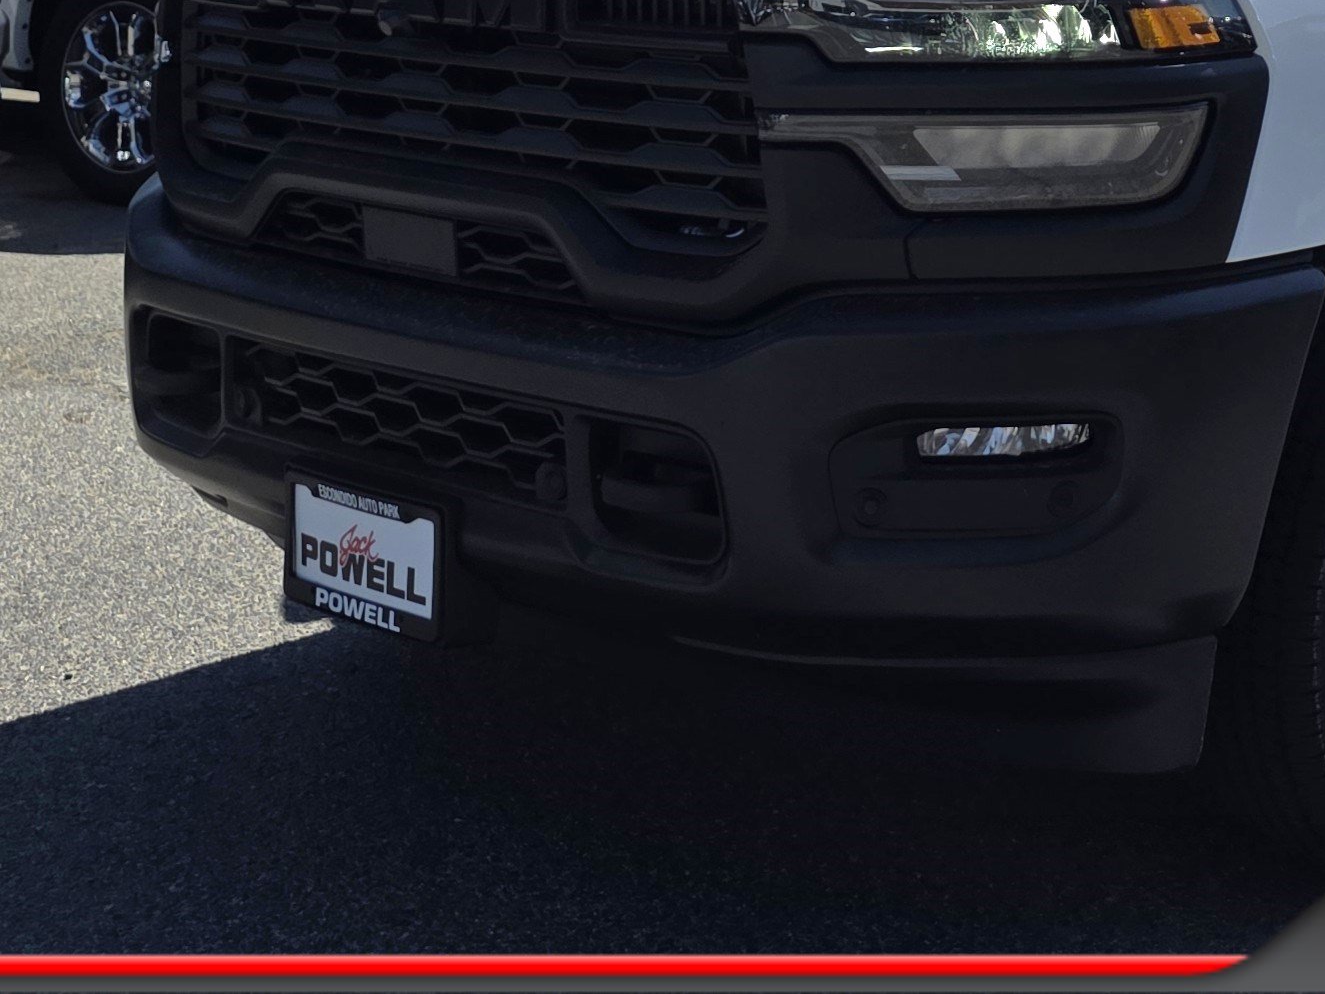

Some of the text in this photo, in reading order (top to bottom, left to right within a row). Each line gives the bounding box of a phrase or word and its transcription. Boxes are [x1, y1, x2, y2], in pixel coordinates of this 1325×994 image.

[317, 483, 401, 520] ESCONDIDO AUTO PARK
[339, 524, 380, 567] Jack
[301, 532, 427, 607] POWELL
[315, 587, 401, 633] POWELL
